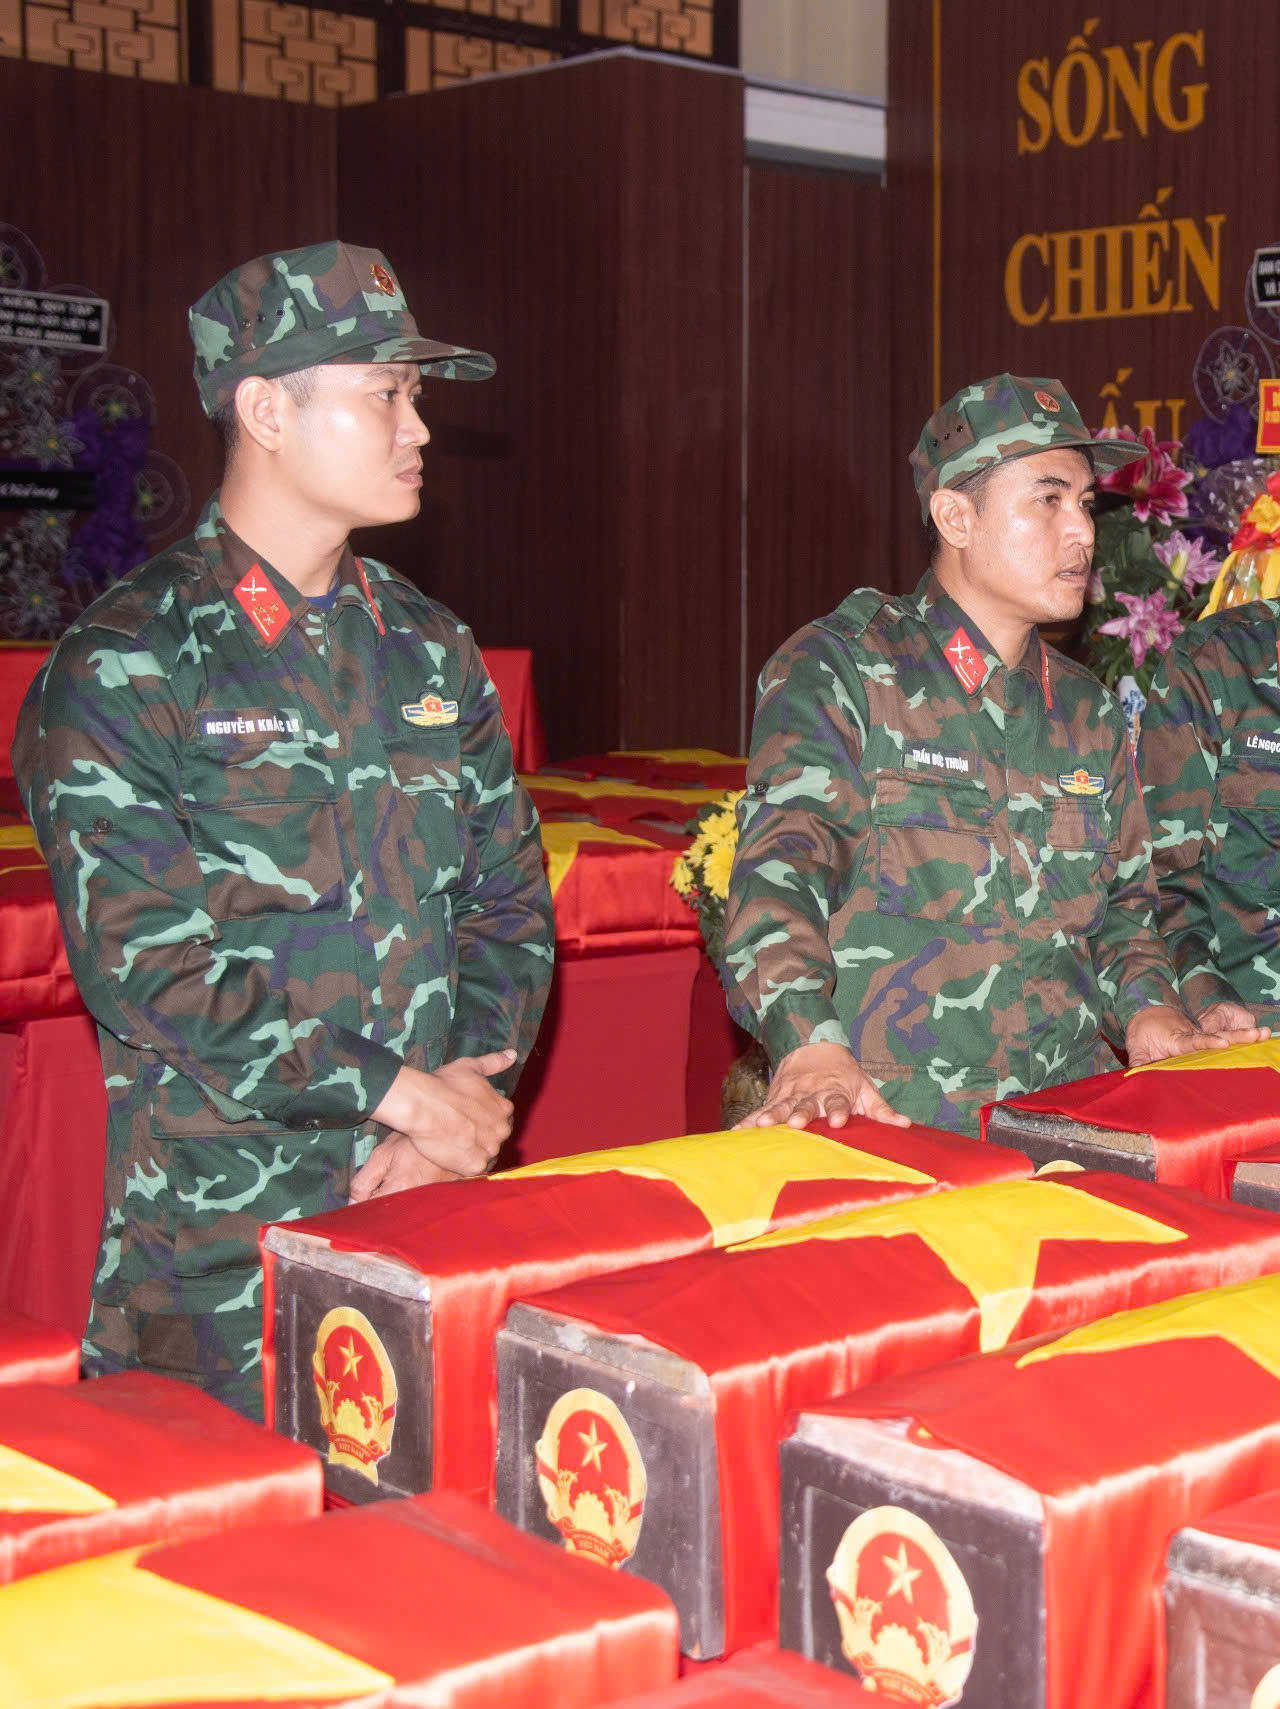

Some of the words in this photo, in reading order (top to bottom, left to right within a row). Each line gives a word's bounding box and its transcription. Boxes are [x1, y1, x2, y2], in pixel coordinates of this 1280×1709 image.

[1018, 18, 1209, 154] SỐNG
[1005, 187, 1226, 326] CHIẾN
[206, 717, 255, 735] NGUYỄN
[257, 716, 285, 732] KHẮC
[1246, 735, 1259, 748] LÊ
